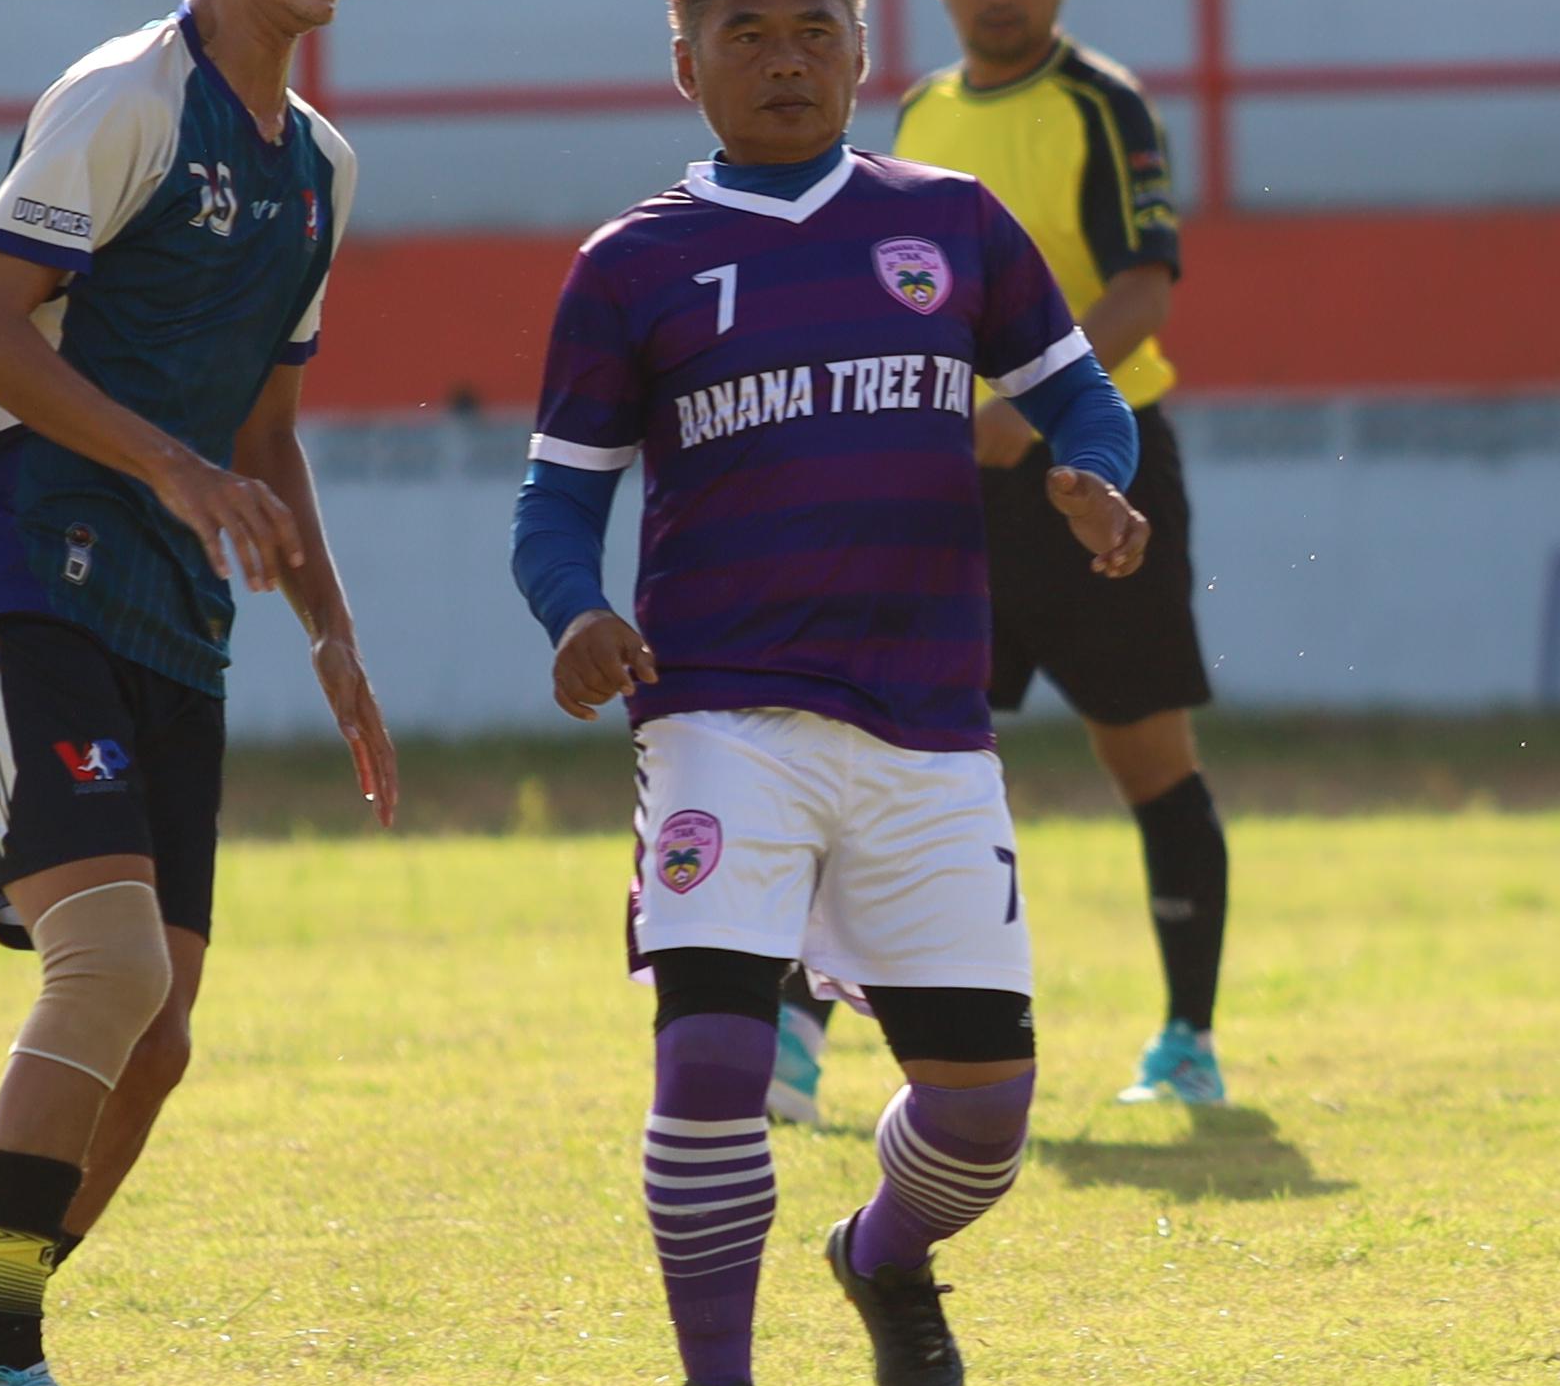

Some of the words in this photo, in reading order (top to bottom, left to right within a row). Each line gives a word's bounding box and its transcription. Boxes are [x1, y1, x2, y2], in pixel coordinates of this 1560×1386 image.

[691, 262, 739, 335] 7
[674, 365, 814, 449] BANANA
[824, 354, 927, 414] TREE
[992, 845, 1019, 926] 7
